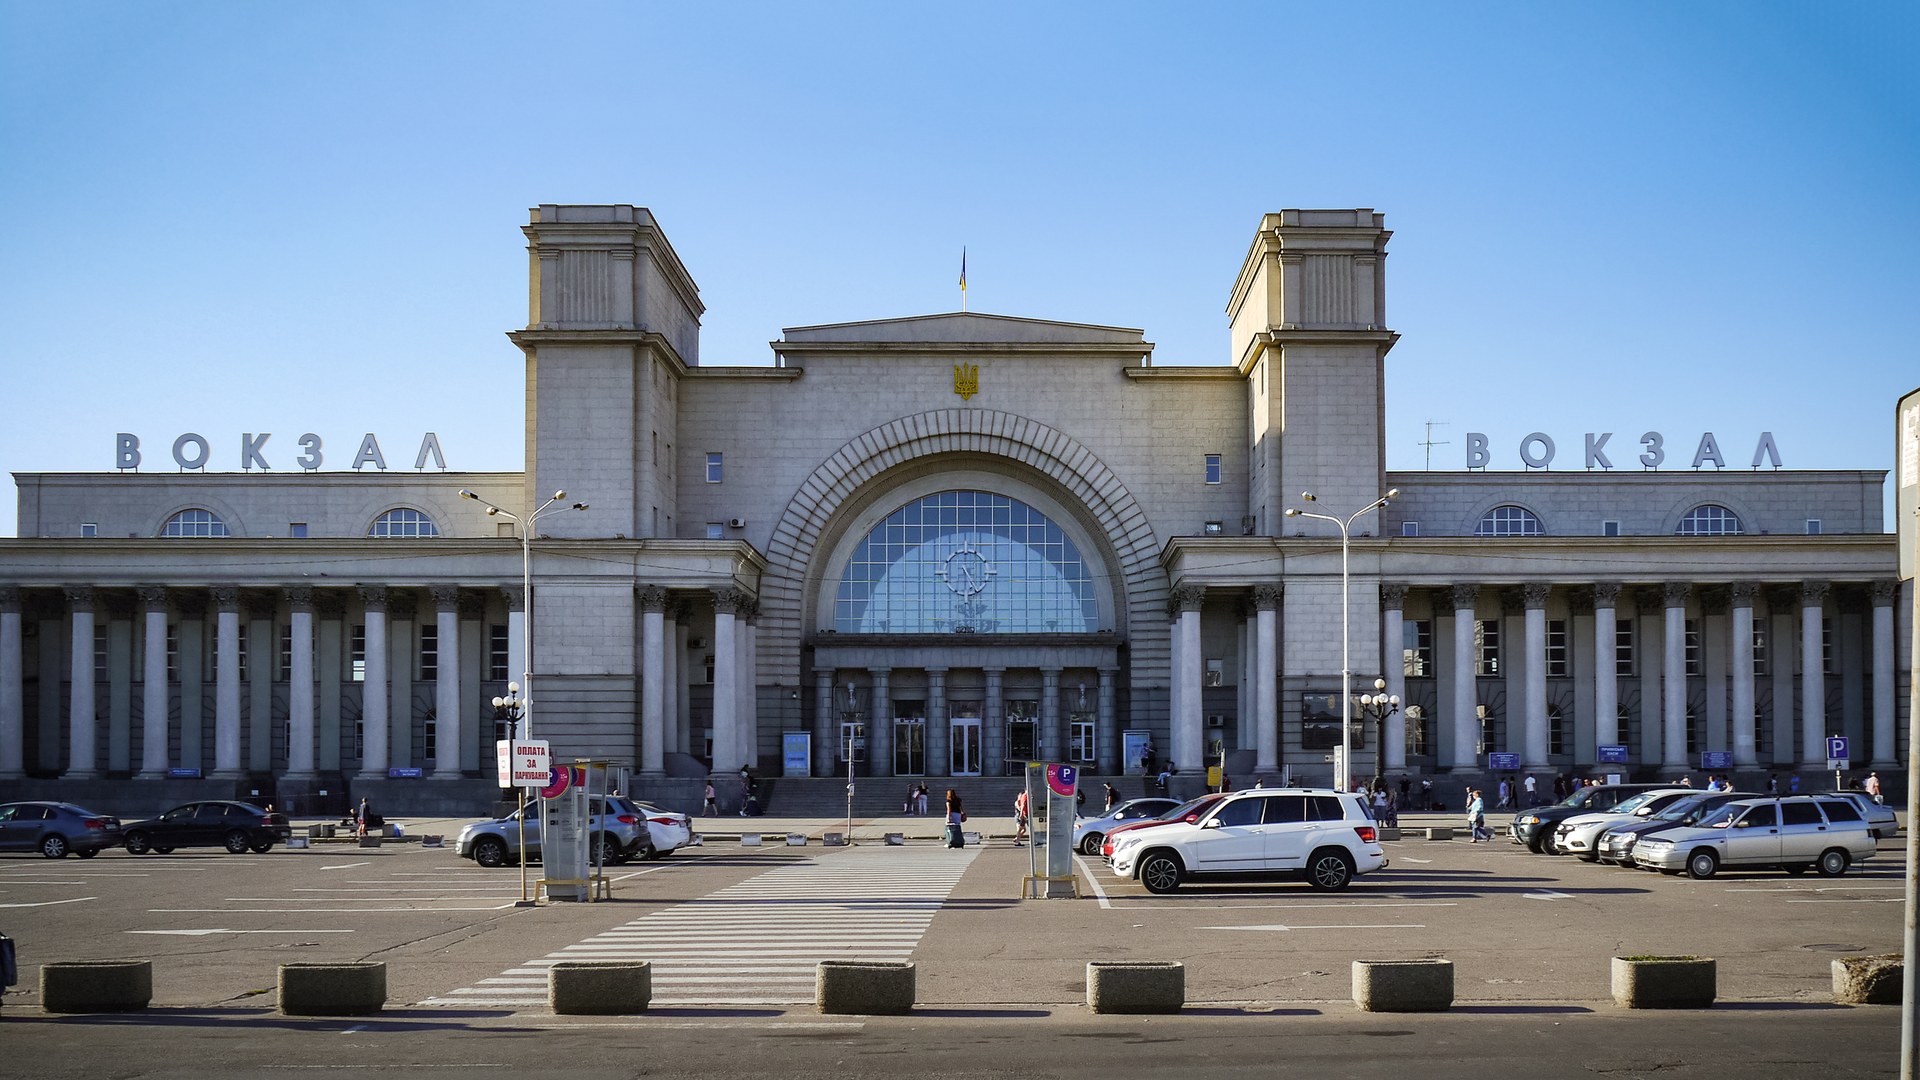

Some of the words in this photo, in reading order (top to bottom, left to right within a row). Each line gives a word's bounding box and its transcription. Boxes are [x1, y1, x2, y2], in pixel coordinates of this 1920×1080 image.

[116, 433, 446, 469] ВОКЗАЛ
[1467, 431, 1782, 468] ВОКЗАЛ
[517, 746, 546, 756] ОПЛАТА
[1832, 739, 1845, 758] P
[526, 759, 537, 768] ЗА
